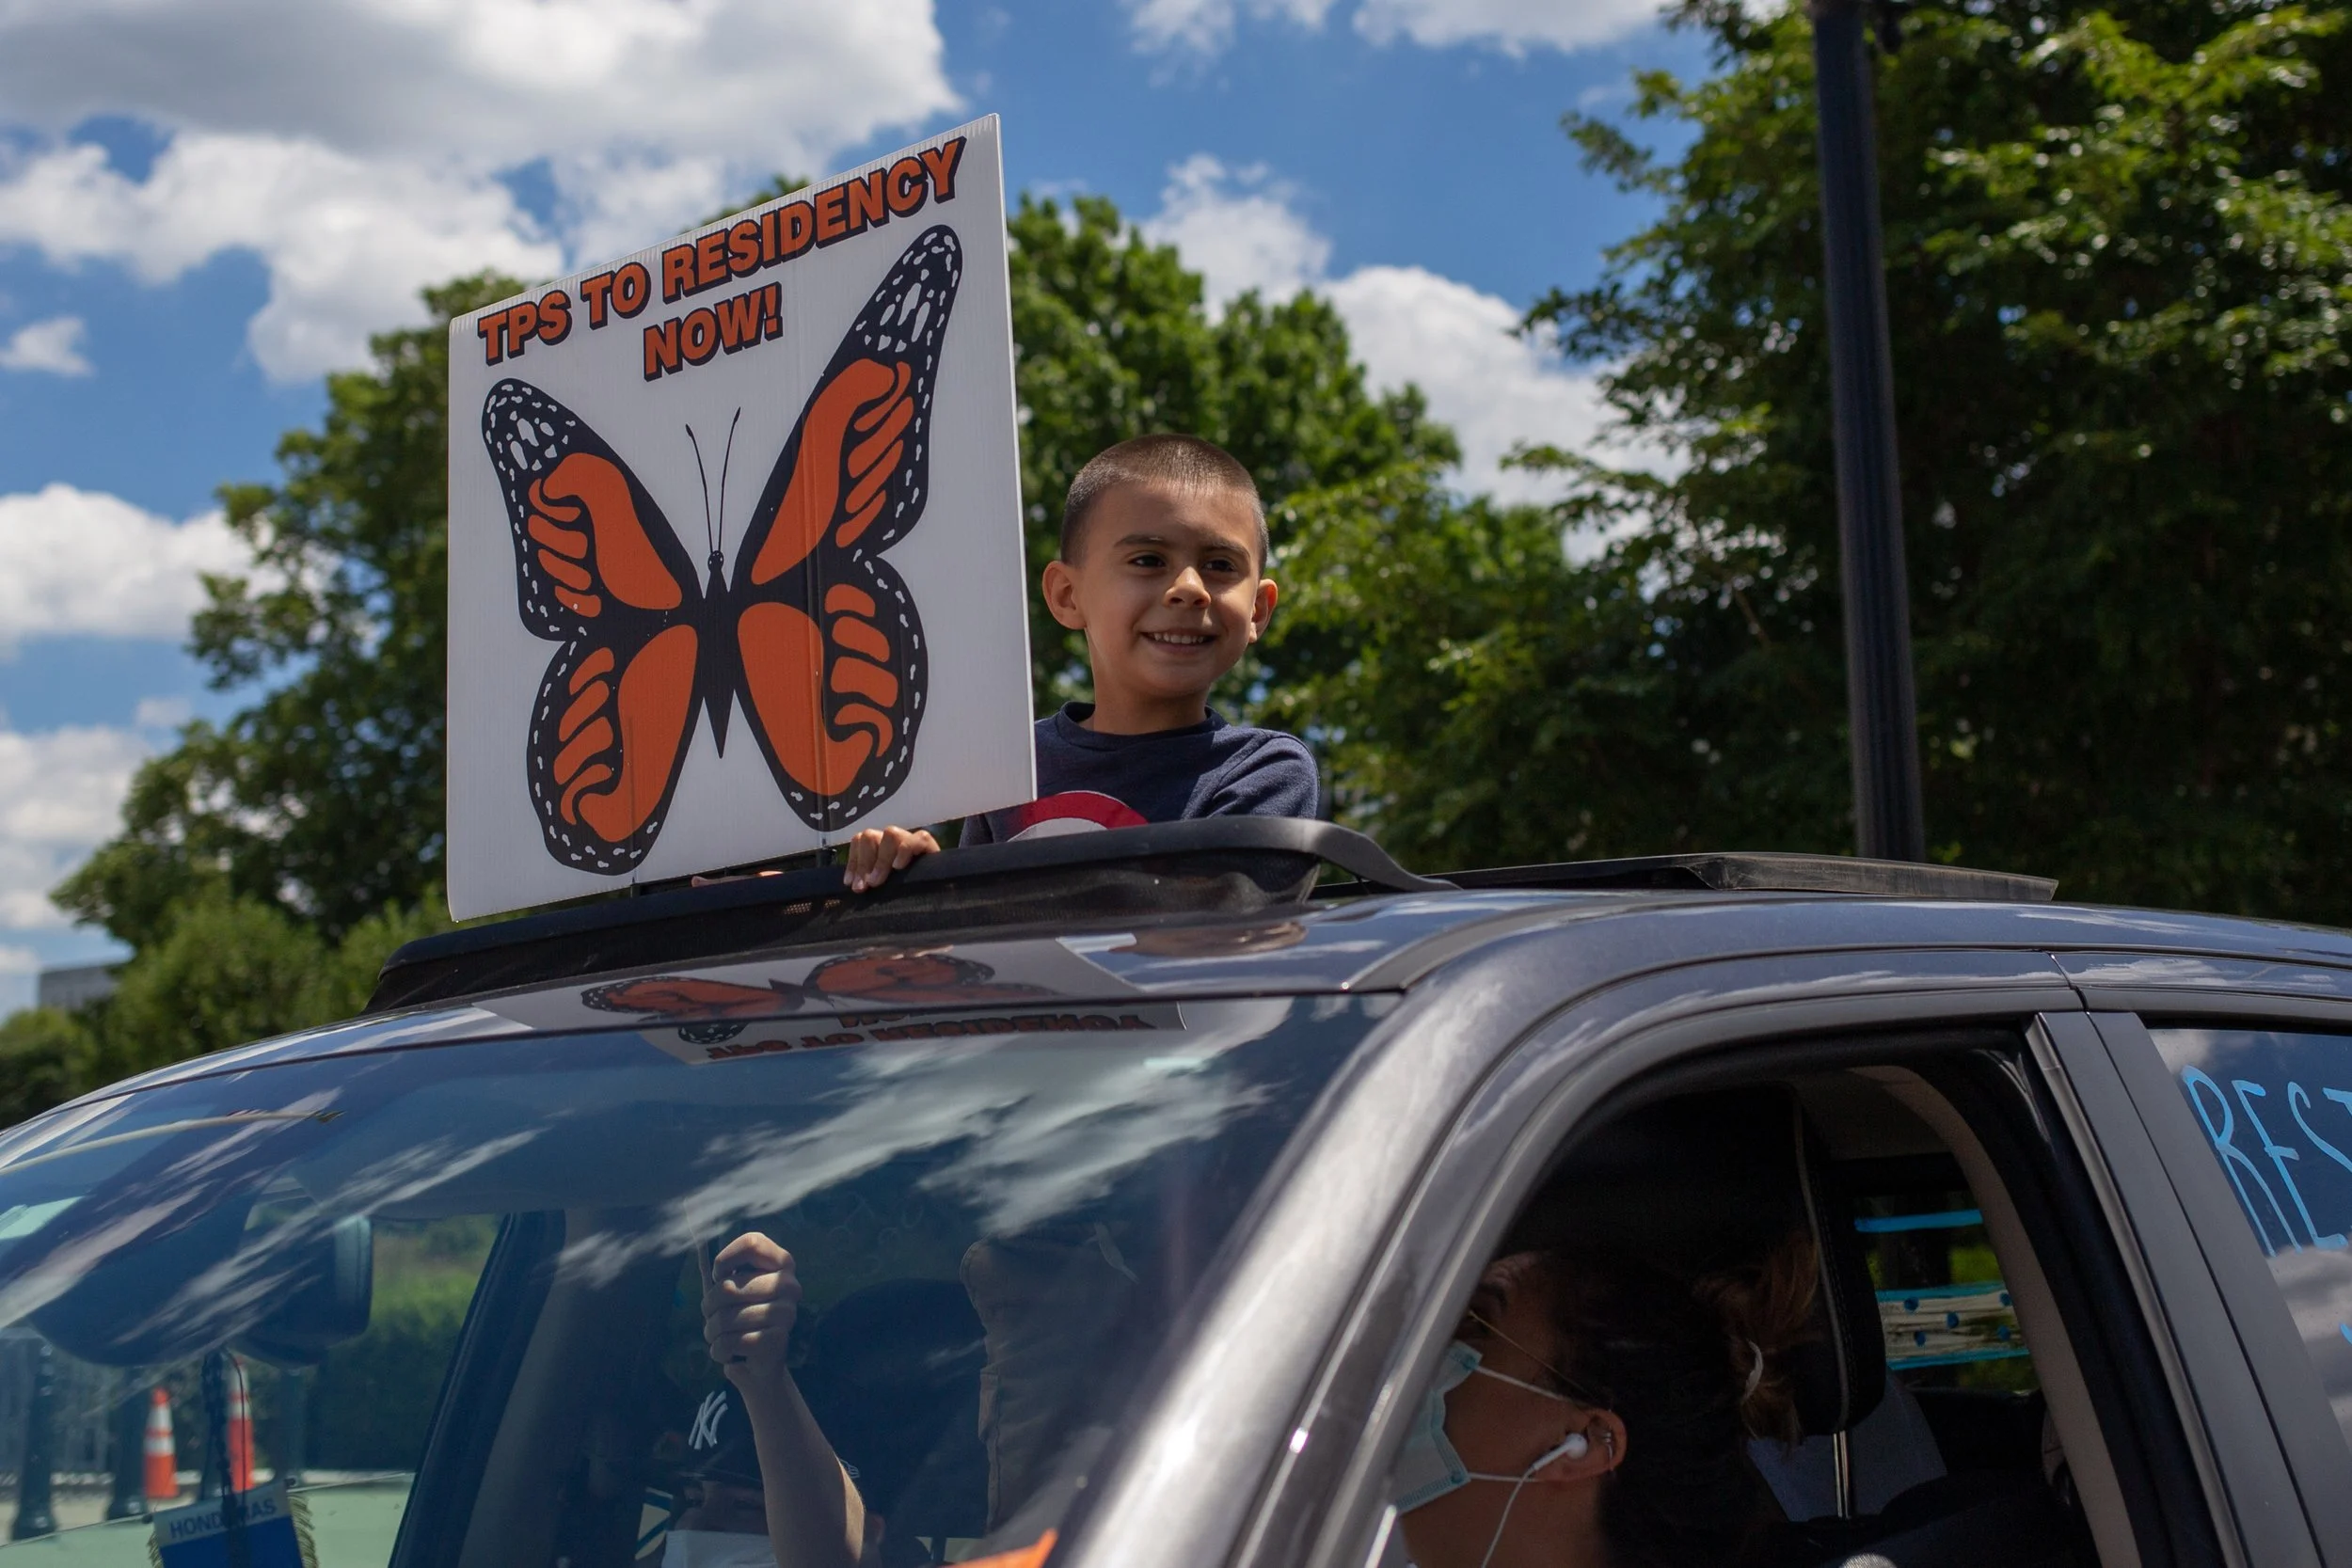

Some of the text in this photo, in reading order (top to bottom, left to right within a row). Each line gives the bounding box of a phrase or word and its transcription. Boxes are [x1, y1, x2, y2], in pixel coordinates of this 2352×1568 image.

[478, 136, 966, 366] TPS TO RESIDENCY
[644, 282, 783, 381] NOW!
[170, 1497, 278, 1540] HONDAS
